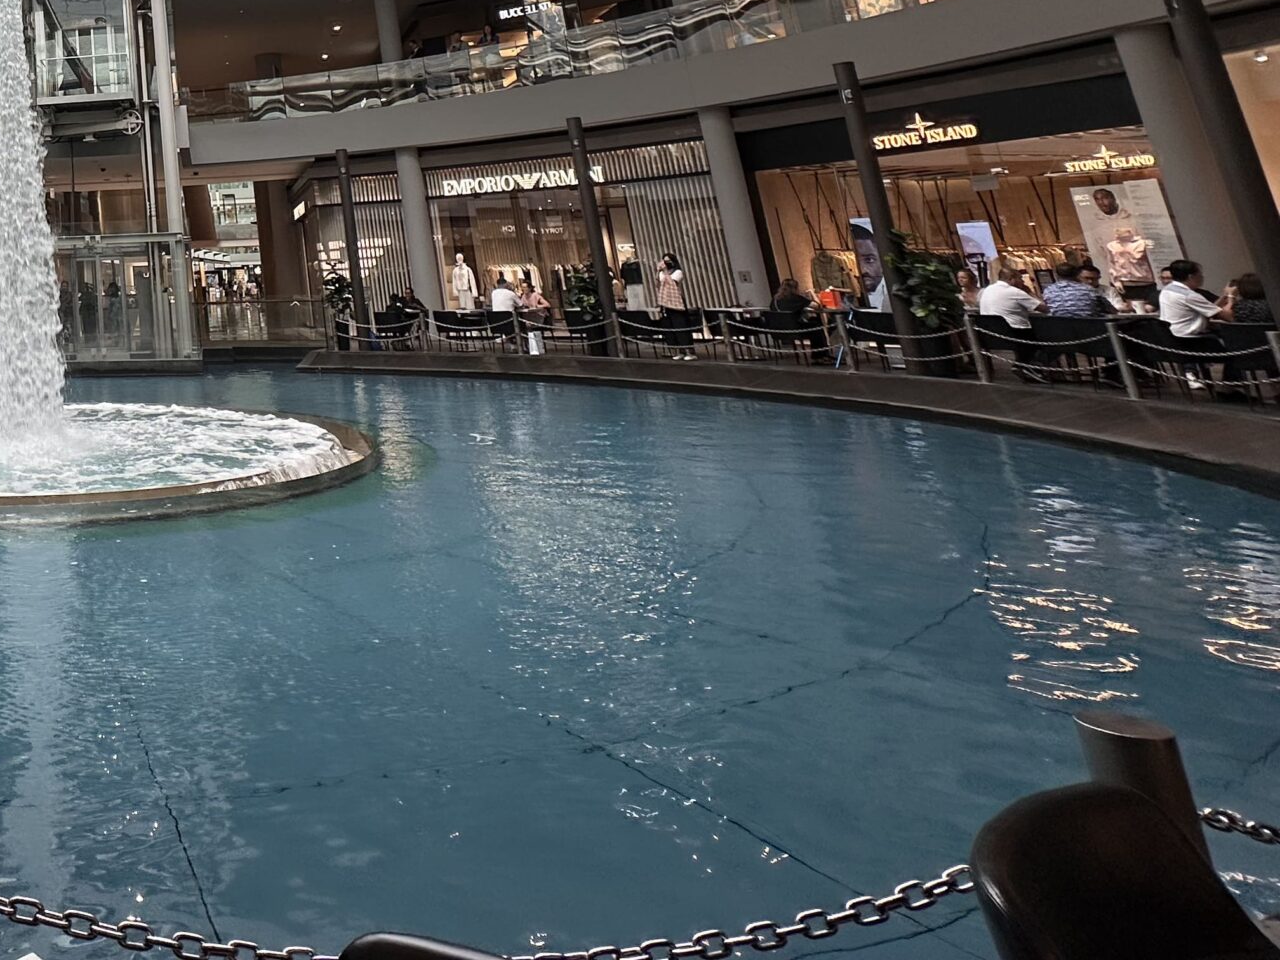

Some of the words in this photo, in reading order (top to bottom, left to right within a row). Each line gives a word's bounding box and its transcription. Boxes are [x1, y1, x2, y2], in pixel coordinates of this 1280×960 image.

[873, 132, 921, 150] STONE
[925, 124, 978, 144] ISLAND
[1065, 159, 1106, 172] STONE
[1111, 154, 1154, 169] ISLAND
[443, 175, 515, 196] EMPORIO
[539, 166, 604, 188] ARMNI
